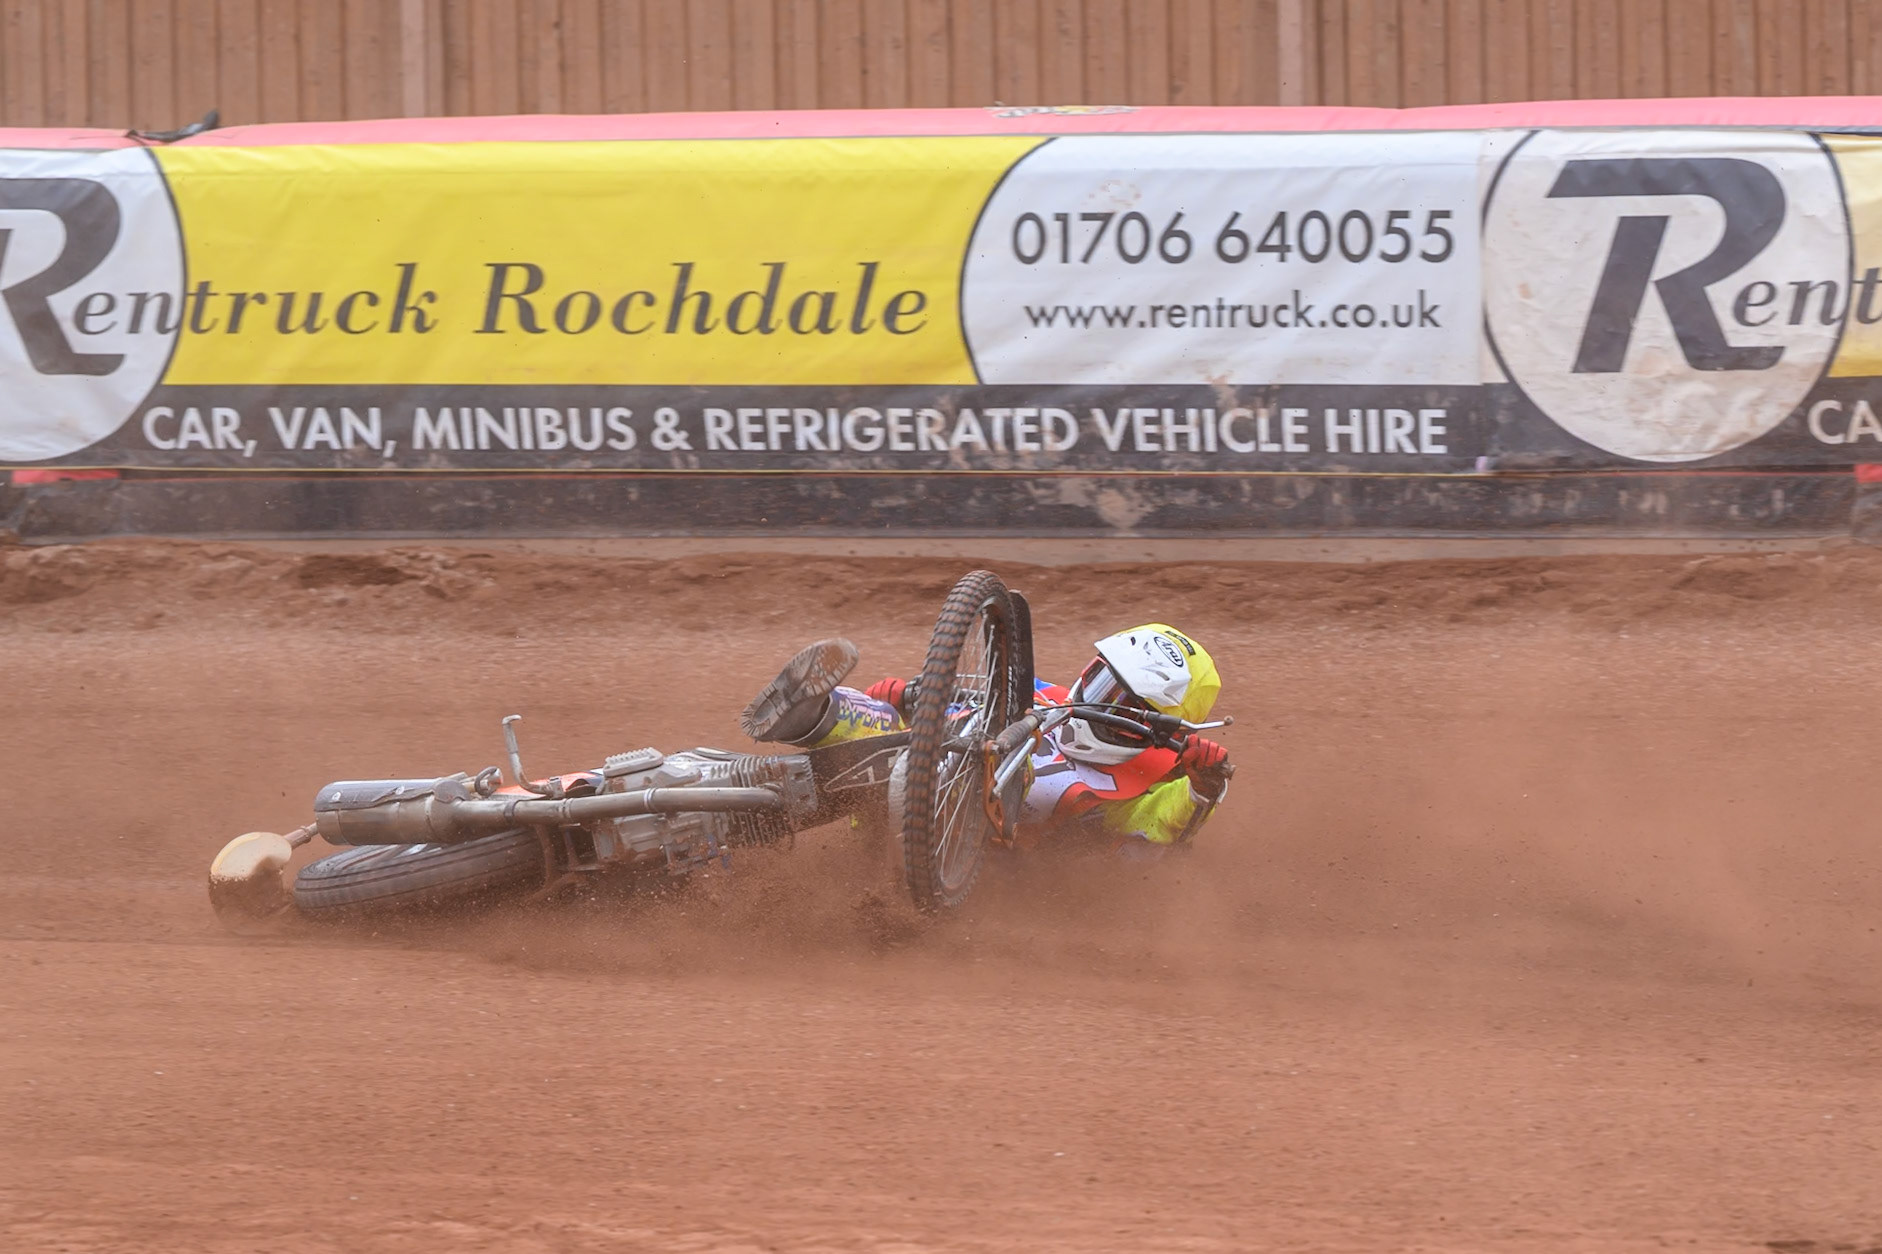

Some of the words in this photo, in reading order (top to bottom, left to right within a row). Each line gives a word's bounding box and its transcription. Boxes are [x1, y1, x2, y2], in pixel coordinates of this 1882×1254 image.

[1012, 211, 1192, 265] 01706
[1215, 209, 1454, 264] 640055
[473, 262, 928, 336] Rochdale
[1024, 289, 1441, 329] www.rentruck.co.uk
[142, 406, 258, 458] CAR,
[268, 407, 398, 459] VAN,
[411, 406, 637, 452] MINIBUS
[650, 407, 692, 452] &
[704, 407, 1079, 453] REFRIGERATED
[1091, 407, 1309, 454] VEHICLE
[1324, 408, 1447, 455] HIRE
